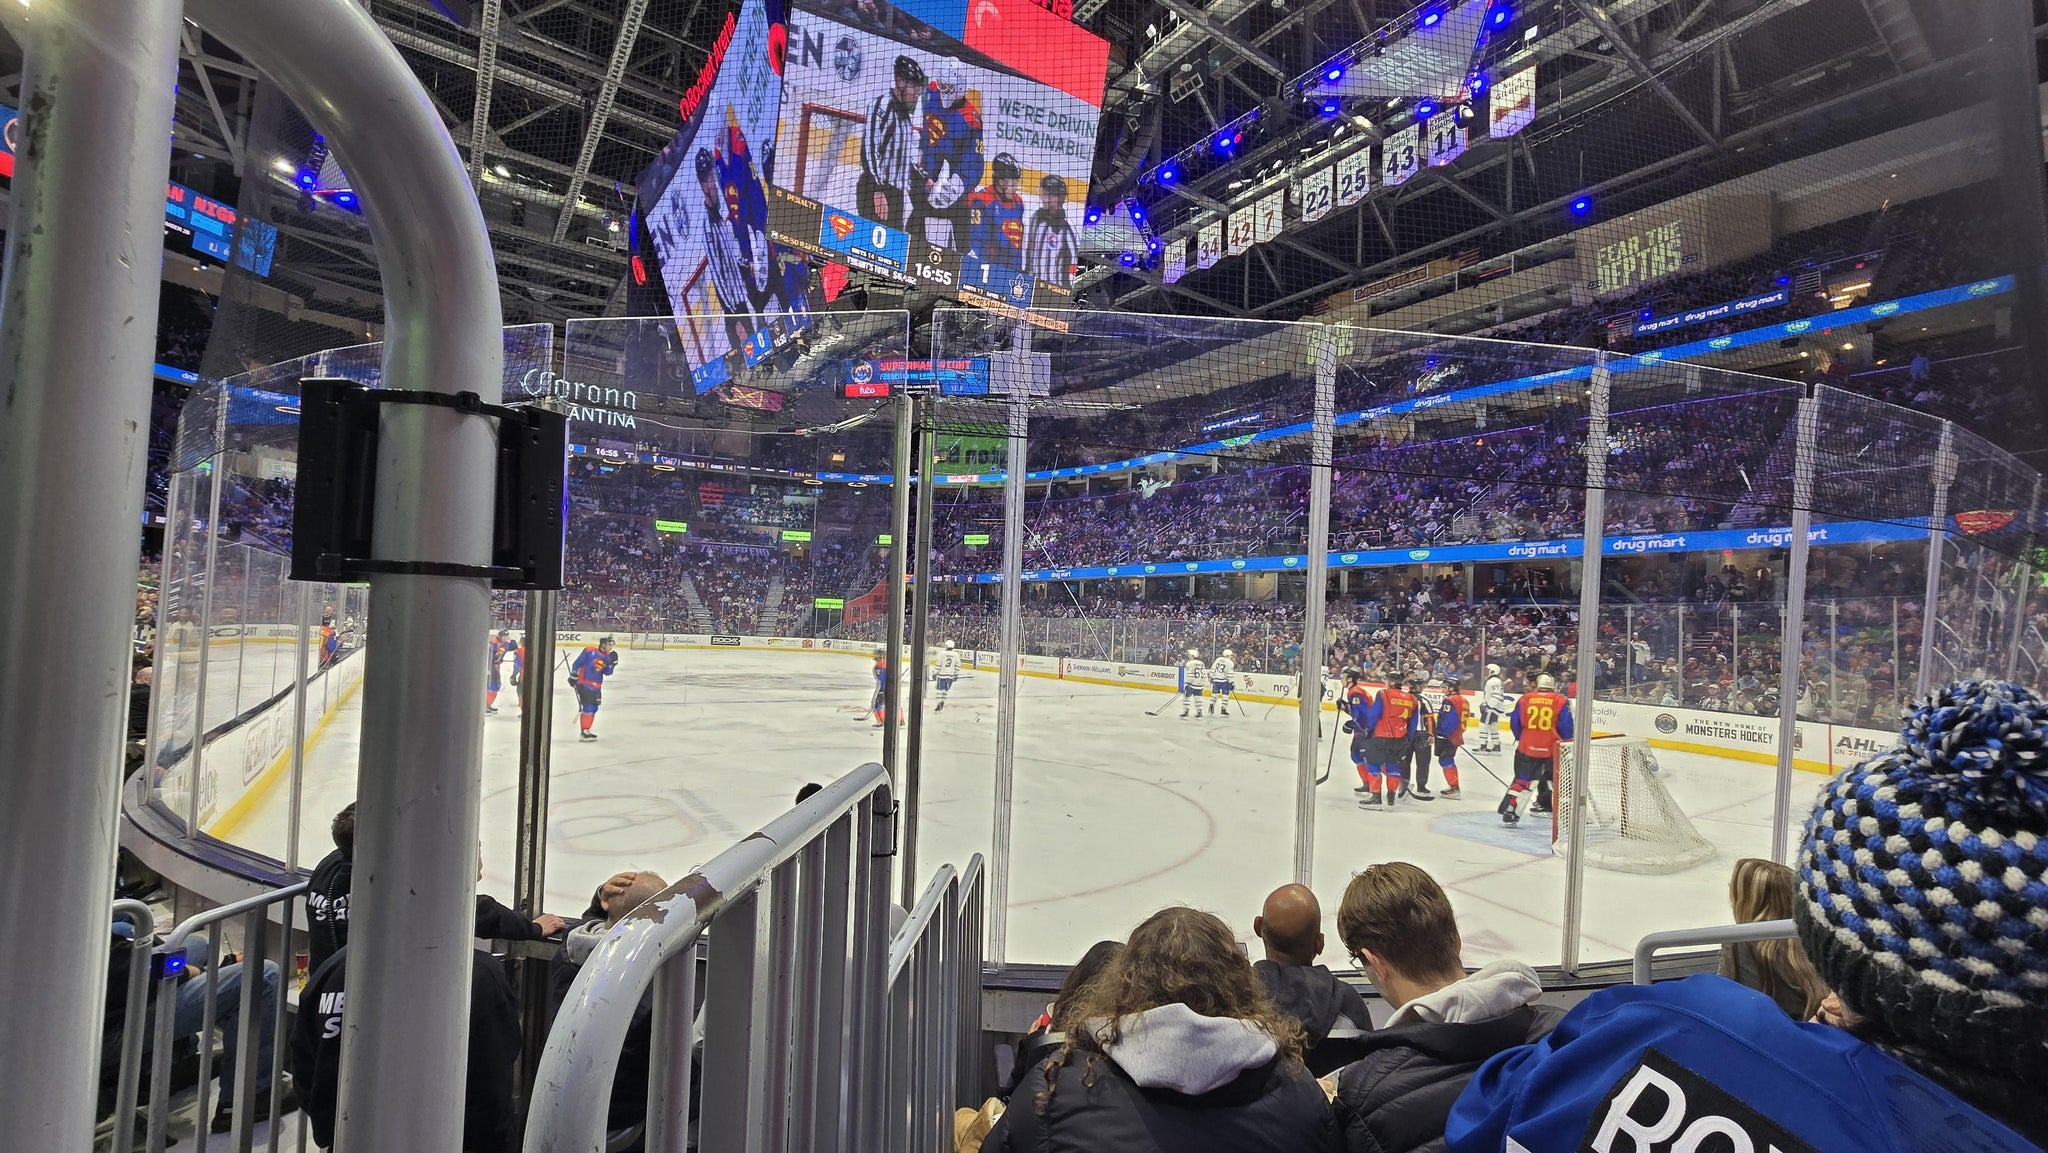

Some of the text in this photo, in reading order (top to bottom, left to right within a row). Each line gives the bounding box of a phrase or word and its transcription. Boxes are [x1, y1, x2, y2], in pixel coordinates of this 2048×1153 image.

[999, 97, 1044, 124] WE'RE
[1434, 126, 1458, 157] 11
[1387, 145, 1414, 176] 43
[1341, 167, 1366, 200] 25
[1306, 185, 1329, 214] 22
[1265, 211, 1274, 232] 7
[872, 226, 887, 249] 0
[1231, 223, 1251, 247] 42
[1201, 237, 1219, 261] 34
[915, 263, 952, 286] 16:55
[980, 264, 990, 284] 1
[880, 361, 932, 371] SUPERMAN
[519, 369, 636, 410] Corona
[568, 406, 636, 429] ANTINA
[595, 447, 619, 457] 16:55
[1613, 536, 1686, 552] drug mart
[1747, 528, 1828, 546] drug art
[1508, 544, 1567, 557] drug mart
[945, 658, 952, 668] 3
[1273, 684, 1290, 695] nrg
[1527, 706, 1554, 731] 28
[1734, 723, 1755, 731] HOME
[1685, 724, 1774, 744] MONSTERS HOCKEY
